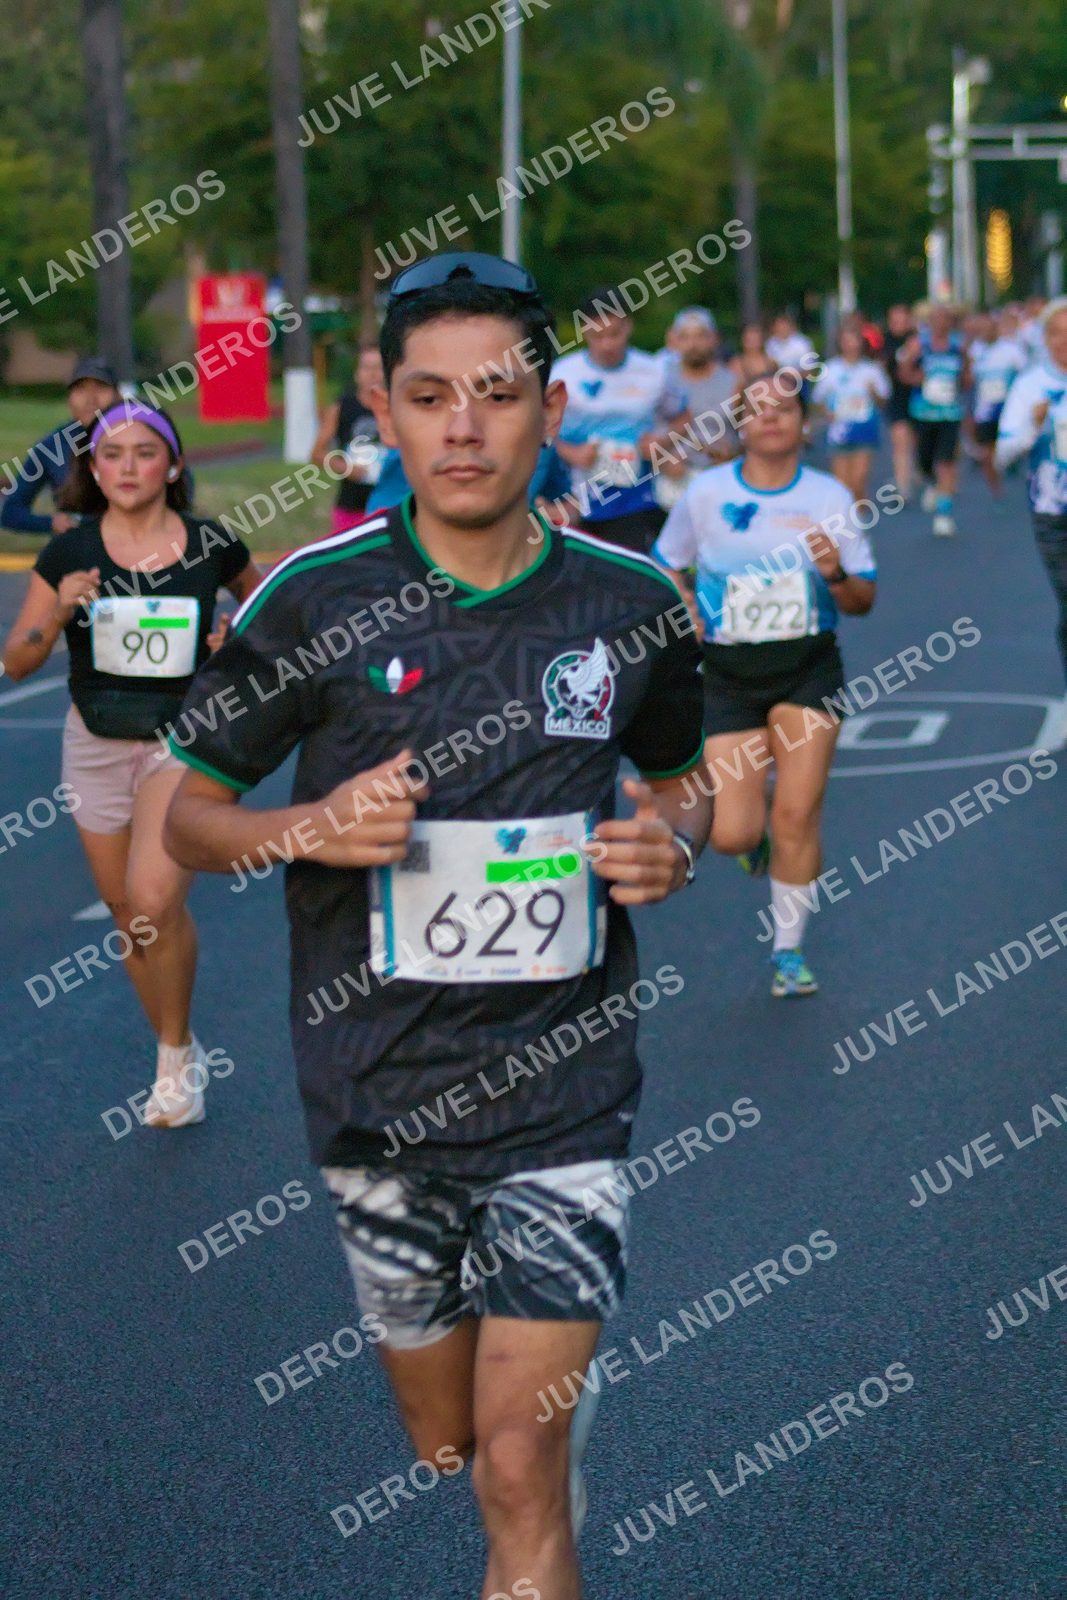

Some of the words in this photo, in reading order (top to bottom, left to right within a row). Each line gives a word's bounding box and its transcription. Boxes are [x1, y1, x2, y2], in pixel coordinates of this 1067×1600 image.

[730, 601, 803, 632] 1922
[122, 631, 168, 664] 90
[424, 888, 565, 958] 629
